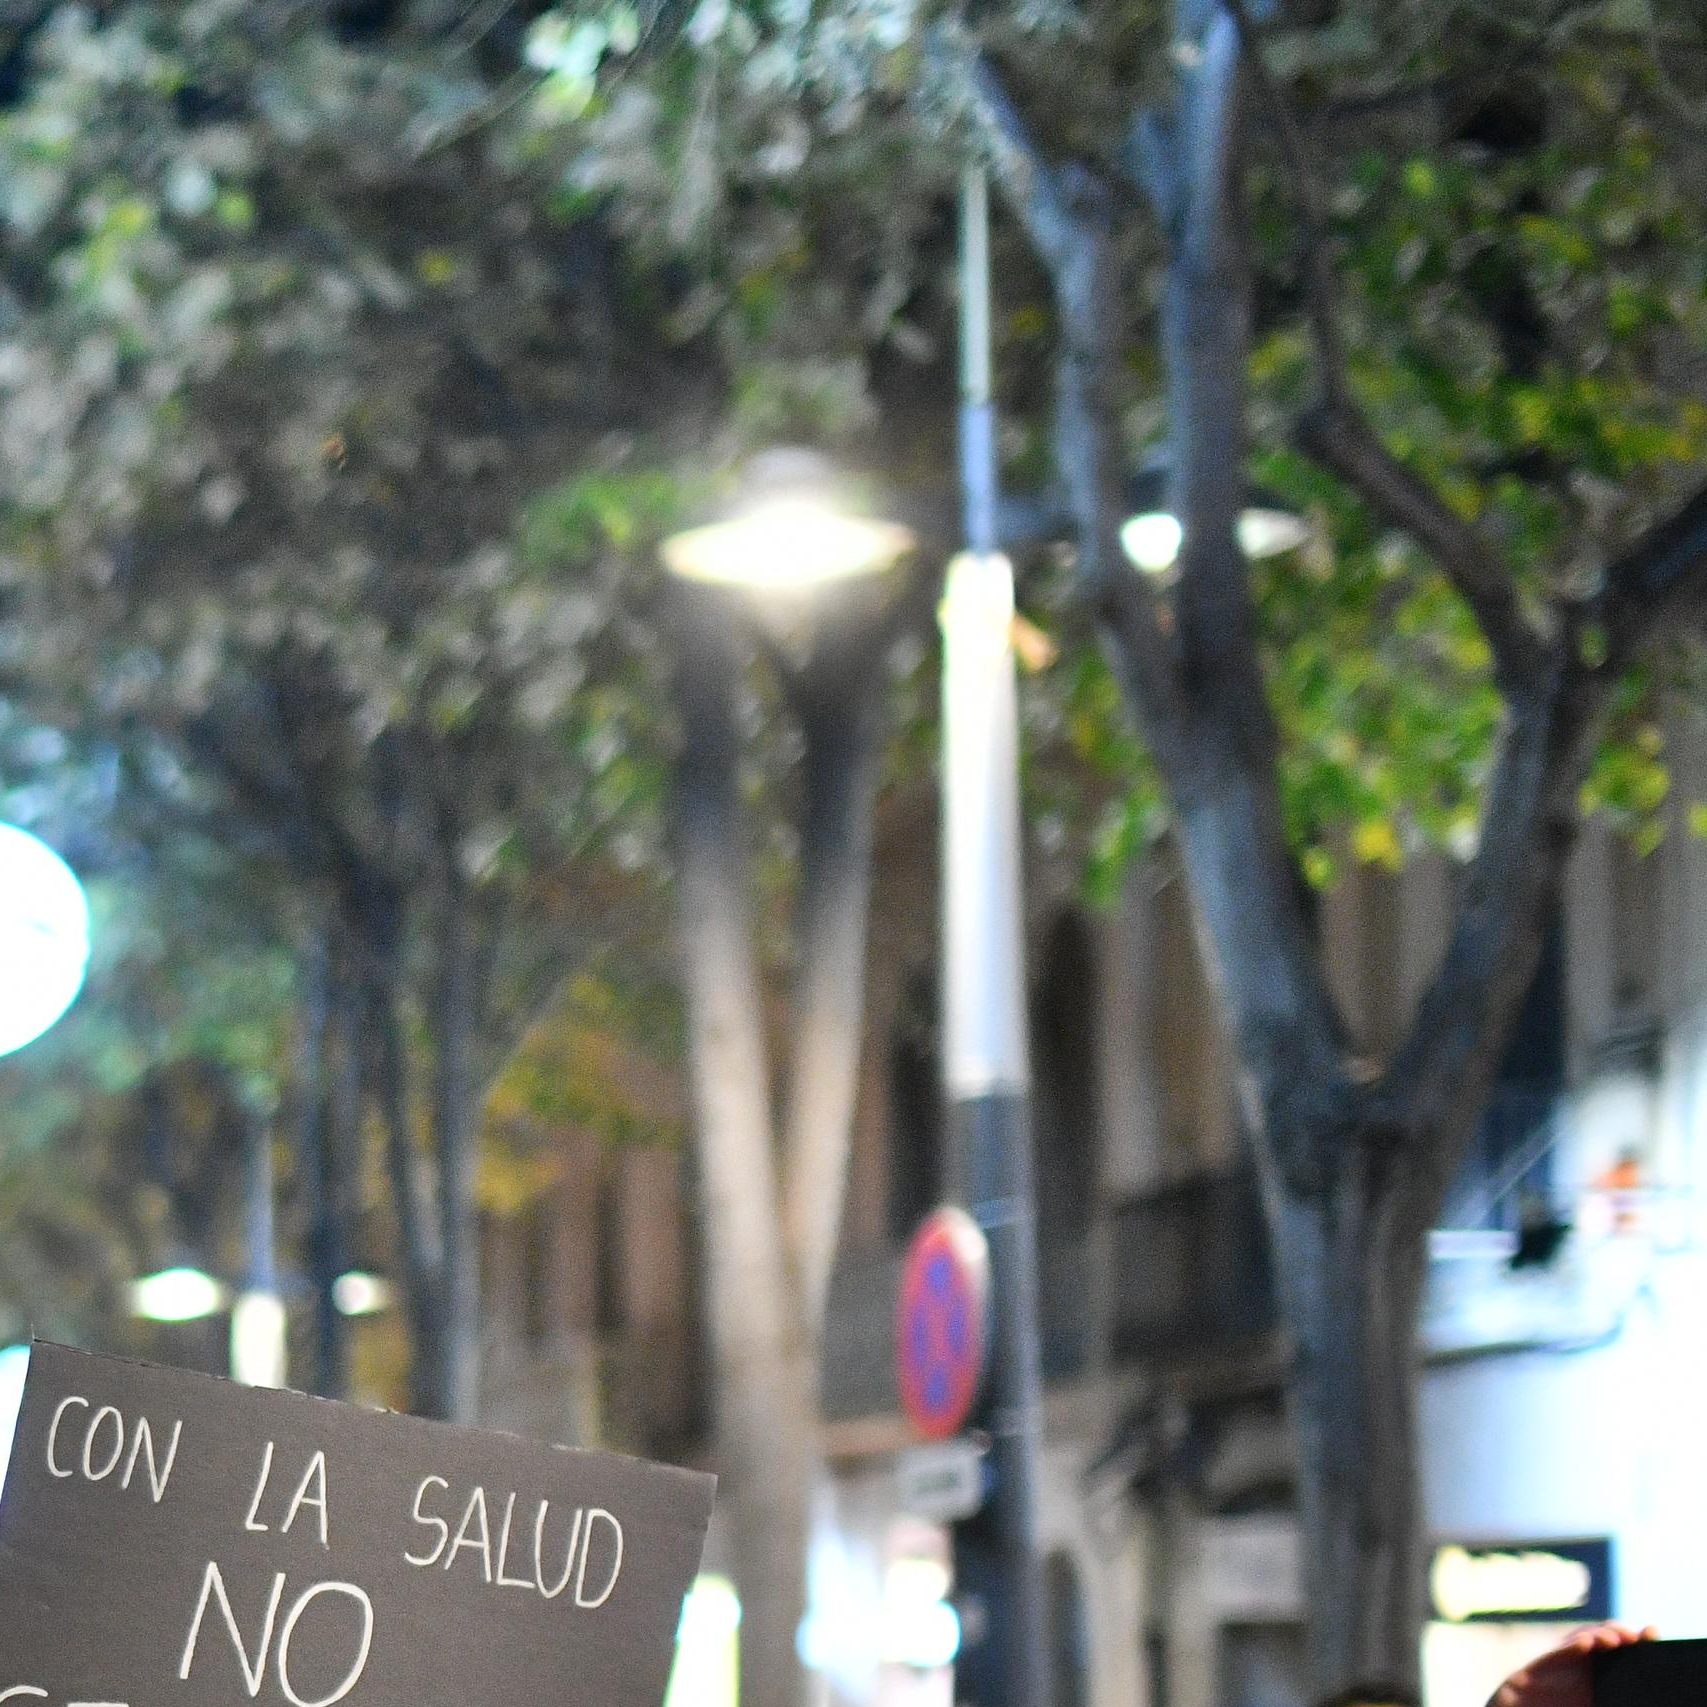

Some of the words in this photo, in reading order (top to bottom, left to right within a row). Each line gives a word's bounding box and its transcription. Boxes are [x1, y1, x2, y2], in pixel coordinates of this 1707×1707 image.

[46, 1395, 184, 1504] CON
[244, 1440, 329, 1546] LA
[403, 1474, 625, 1609] SALUD
